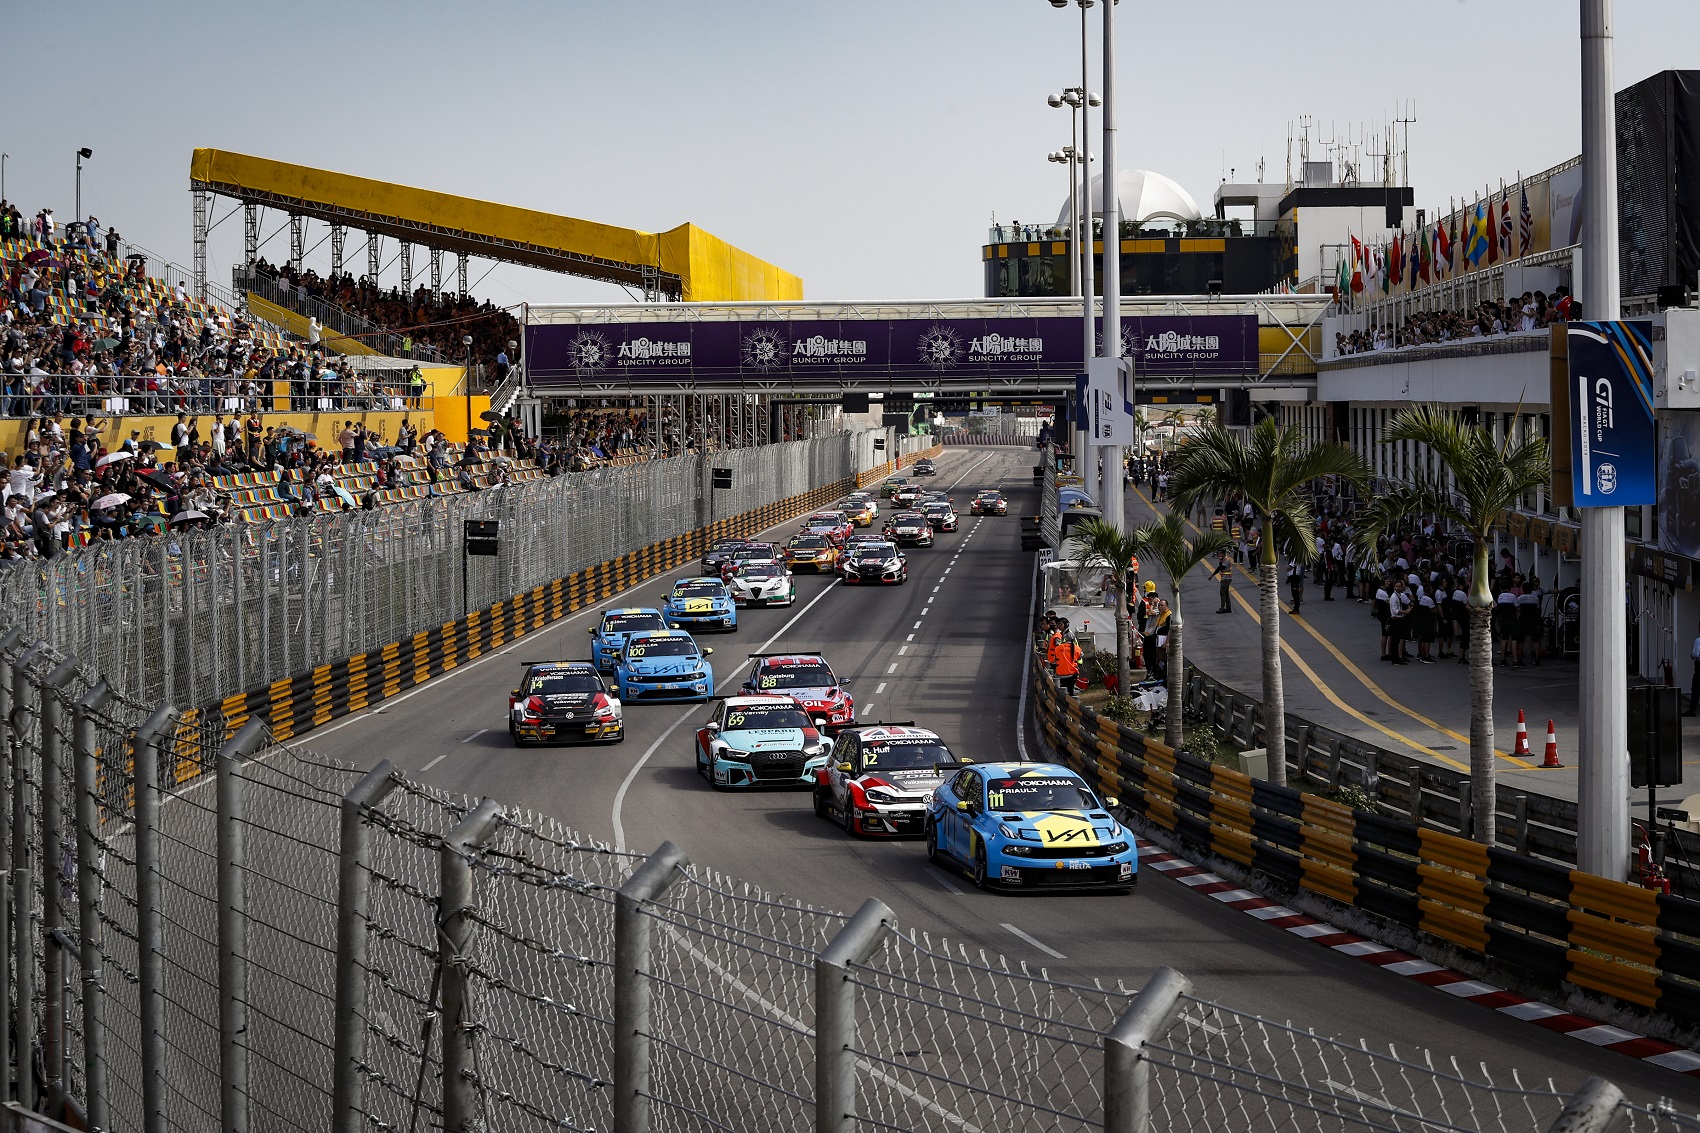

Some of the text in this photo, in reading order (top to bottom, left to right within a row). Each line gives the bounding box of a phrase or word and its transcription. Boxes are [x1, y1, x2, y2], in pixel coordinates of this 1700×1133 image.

[792, 336, 866, 356] 太陽城集團
[968, 333, 1042, 354] 太陽城集團
[1145, 331, 1218, 352] 太陽城集團
[617, 338, 690, 358] 太陽城集團
[1602, 419, 1608, 428] GT
[630, 648, 645, 657] 100
[532, 681, 543, 689] 14
[762, 679, 776, 688] 88
[728, 716, 745, 726] 69
[864, 754, 878, 765] 12
[988, 793, 1004, 807] 111
